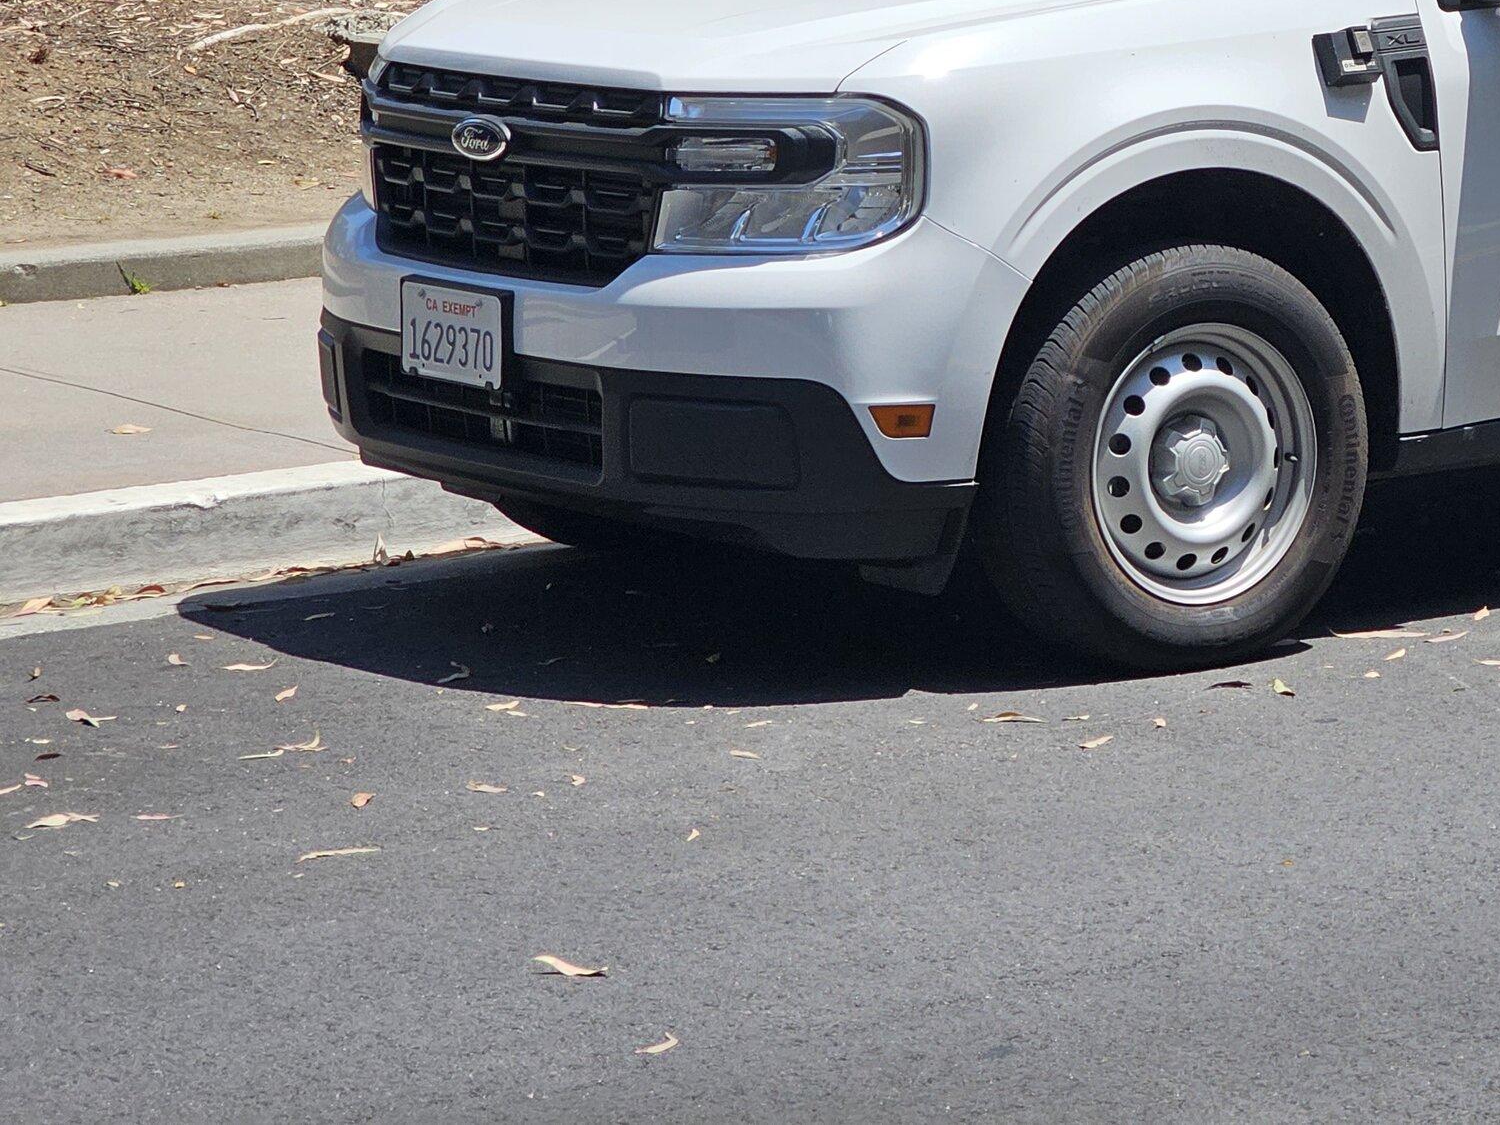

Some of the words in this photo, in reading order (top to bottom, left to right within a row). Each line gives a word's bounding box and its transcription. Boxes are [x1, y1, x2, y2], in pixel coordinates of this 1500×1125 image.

[1386, 33, 1420, 47] XL
[461, 126, 490, 152] Ford
[426, 298, 438, 312] CA
[442, 300, 477, 318] EXEMPT
[409, 318, 494, 372] 1629370
[1336, 393, 1360, 524] Continental
